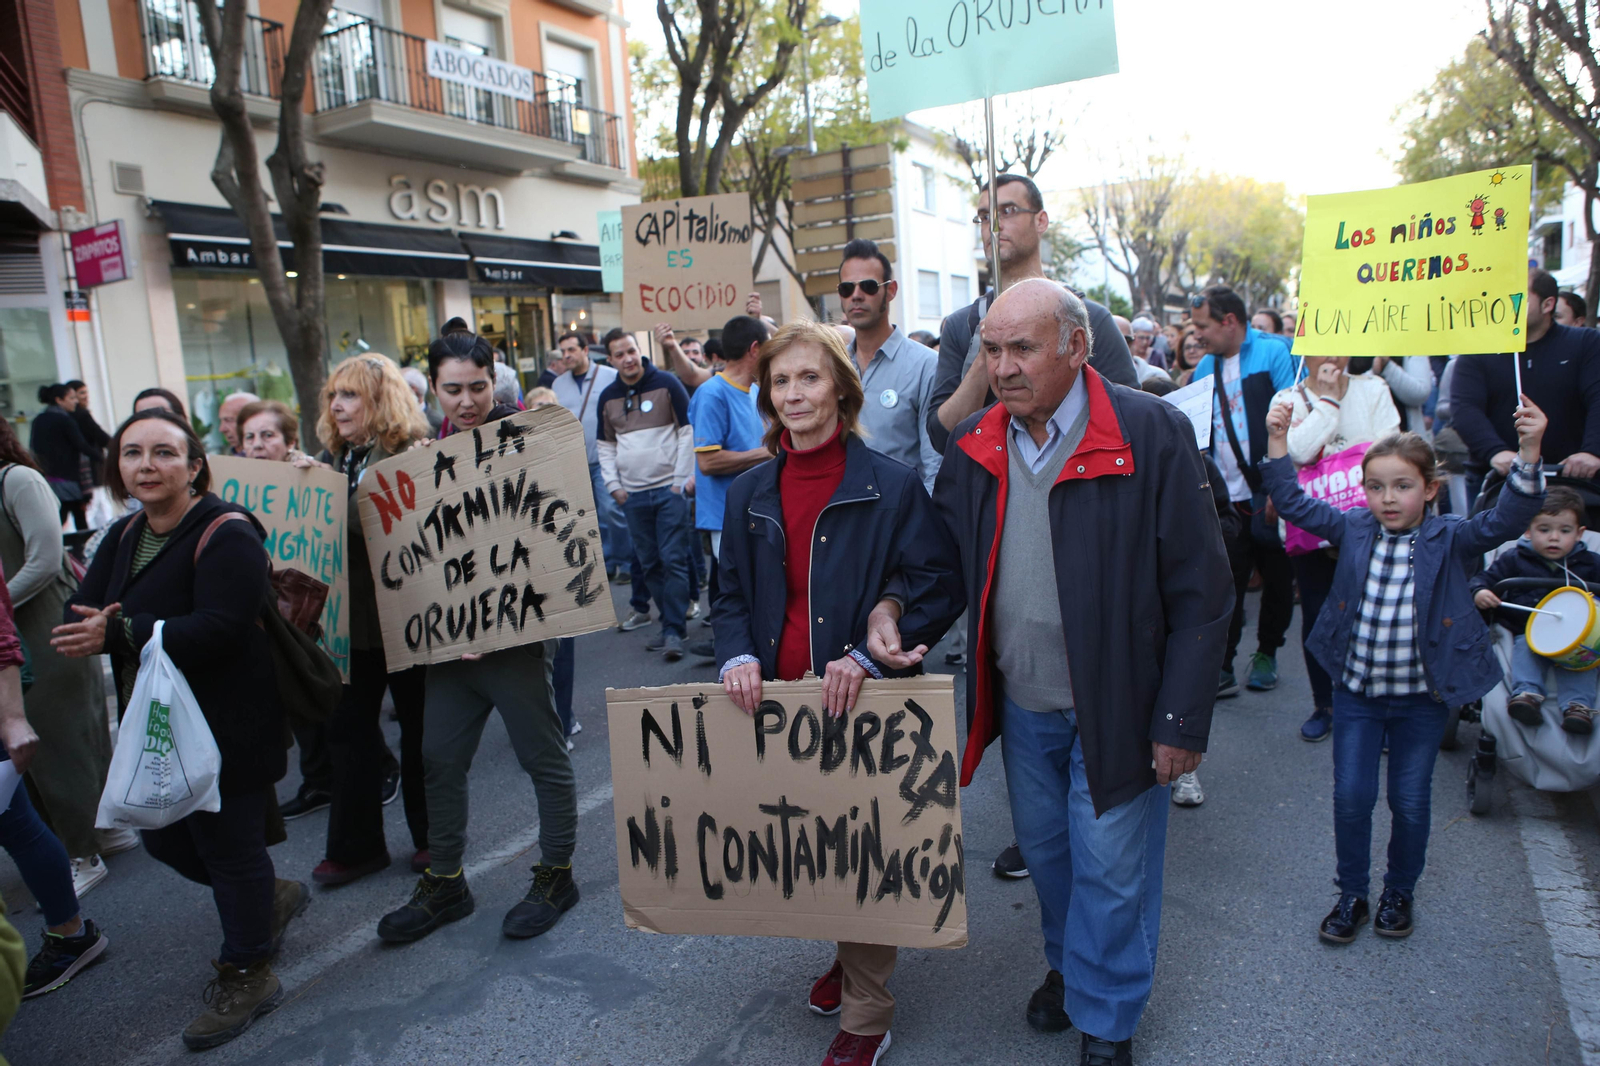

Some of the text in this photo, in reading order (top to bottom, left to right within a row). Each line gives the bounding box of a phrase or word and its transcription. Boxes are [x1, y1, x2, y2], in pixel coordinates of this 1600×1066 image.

[870, 31, 897, 73] de
[906, 16, 943, 58] la
[431, 47, 532, 94] ABOGADOS
[388, 174, 506, 231] asm
[1334, 212, 1457, 250] Los niños
[186, 247, 250, 265] Ambar
[667, 248, 694, 268] ES
[1357, 253, 1492, 284] QUEREMOS...
[639, 281, 737, 313] ECOCIDIO
[1362, 298, 1410, 333] AIRE
[222, 478, 278, 514] QUE
[369, 419, 536, 535] NO A LA
[263, 516, 343, 585] NGAÑEN
[444, 536, 531, 592] DE LA
[404, 578, 549, 653] ORUJERA
[754, 697, 957, 825] POBREZA
